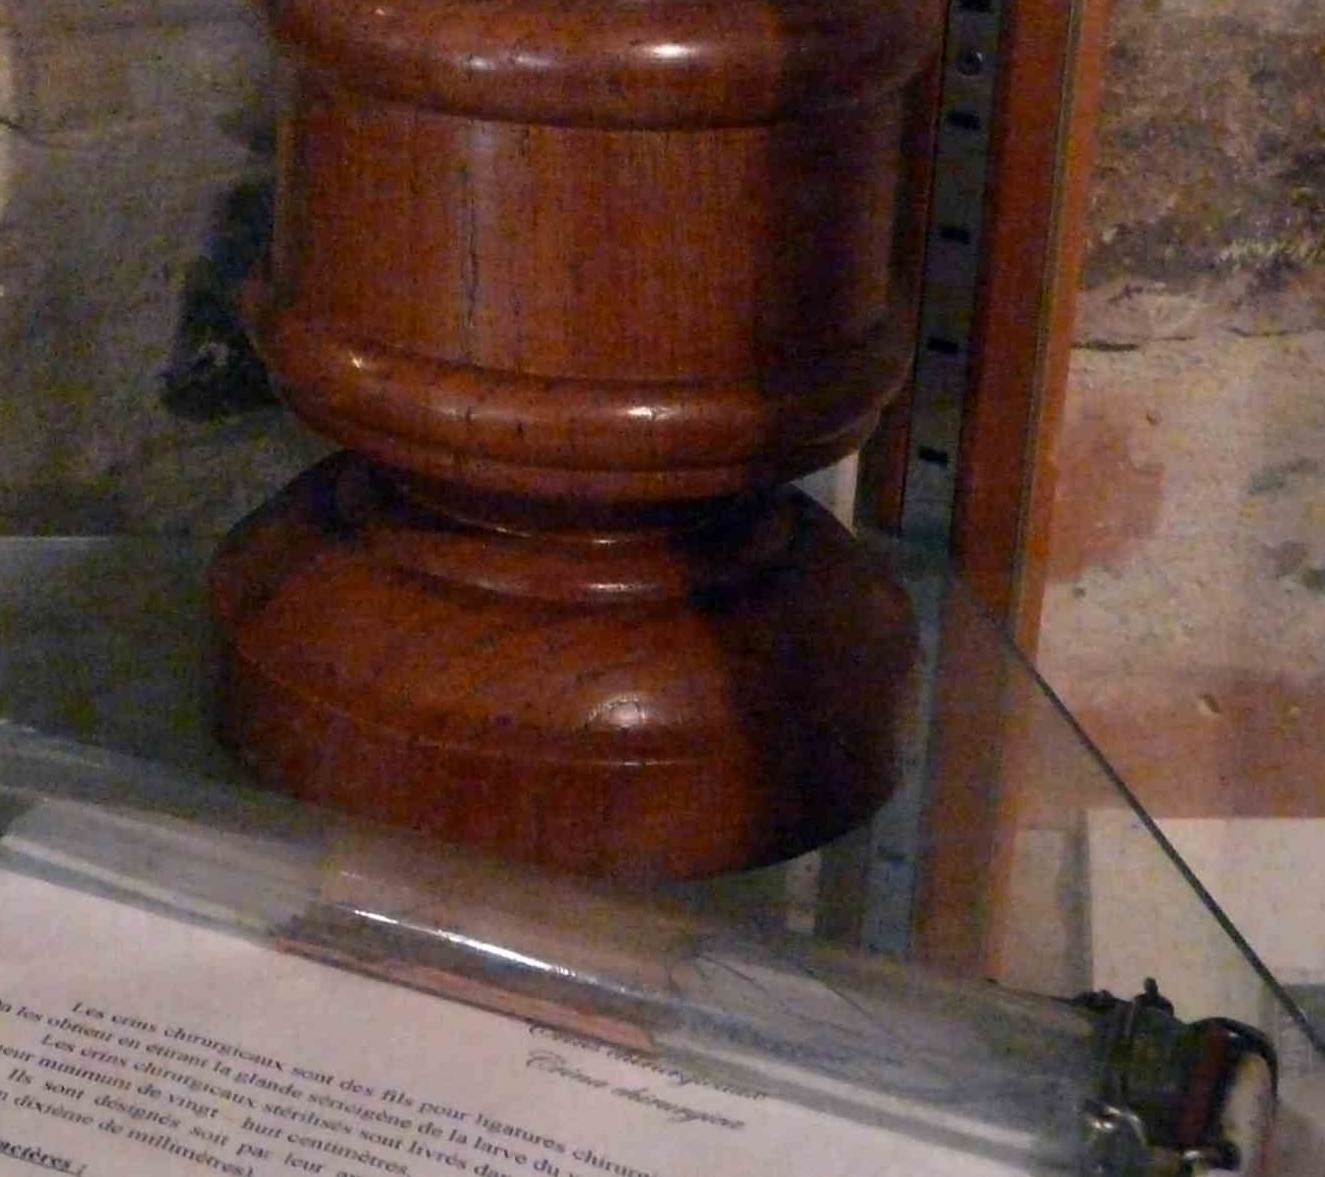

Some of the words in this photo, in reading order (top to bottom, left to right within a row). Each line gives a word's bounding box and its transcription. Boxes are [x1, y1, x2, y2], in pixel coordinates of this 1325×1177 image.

[8, 1068, 33, 1086] Ils
[43, 1080, 85, 1101] sont
[94, 1093, 181, 1129] désignés
[189, 1125, 230, 1148] soit
[236, 1141, 272, 1159] par
[284, 1151, 324, 1174] leur
[13, 1094, 95, 1127] dixième
[98, 1118, 124, 1135] de
[16, 1005, 44, 1022] les
[47, 1015, 115, 1043] obtient
[118, 1035, 142, 1049] en
[213, 1059, 232, 1075] la
[233, 1069, 304, 1100] glande
[417, 1121, 444, 1138] de
[448, 1128, 468, 1145] la
[473, 1135, 527, 1165] larve
[533, 1158, 560, 1177] du
[38, 1057, 132, 1091] minimum
[137, 1083, 162, 1100] de
[168, 1093, 220, 1120] vingt
[242, 1116, 283, 1139] huit
[41, 1033, 76, 1053] Les
[80, 1046, 129, 1068] crins
[133, 1061, 257, 1109] chirurgicaux
[359, 1128, 404, 1150] sont
[407, 1140, 467, 1170] livrés
[72, 1001, 104, 1019] Les
[111, 1013, 157, 1033] crins
[163, 1026, 283, 1073] chirurgicaux
[291, 1066, 334, 1087] sont
[340, 1077, 374, 1097] des
[380, 1088, 415, 1108] fils
[417, 1101, 468, 1122] pour
[475, 1112, 566, 1153] ligatures
